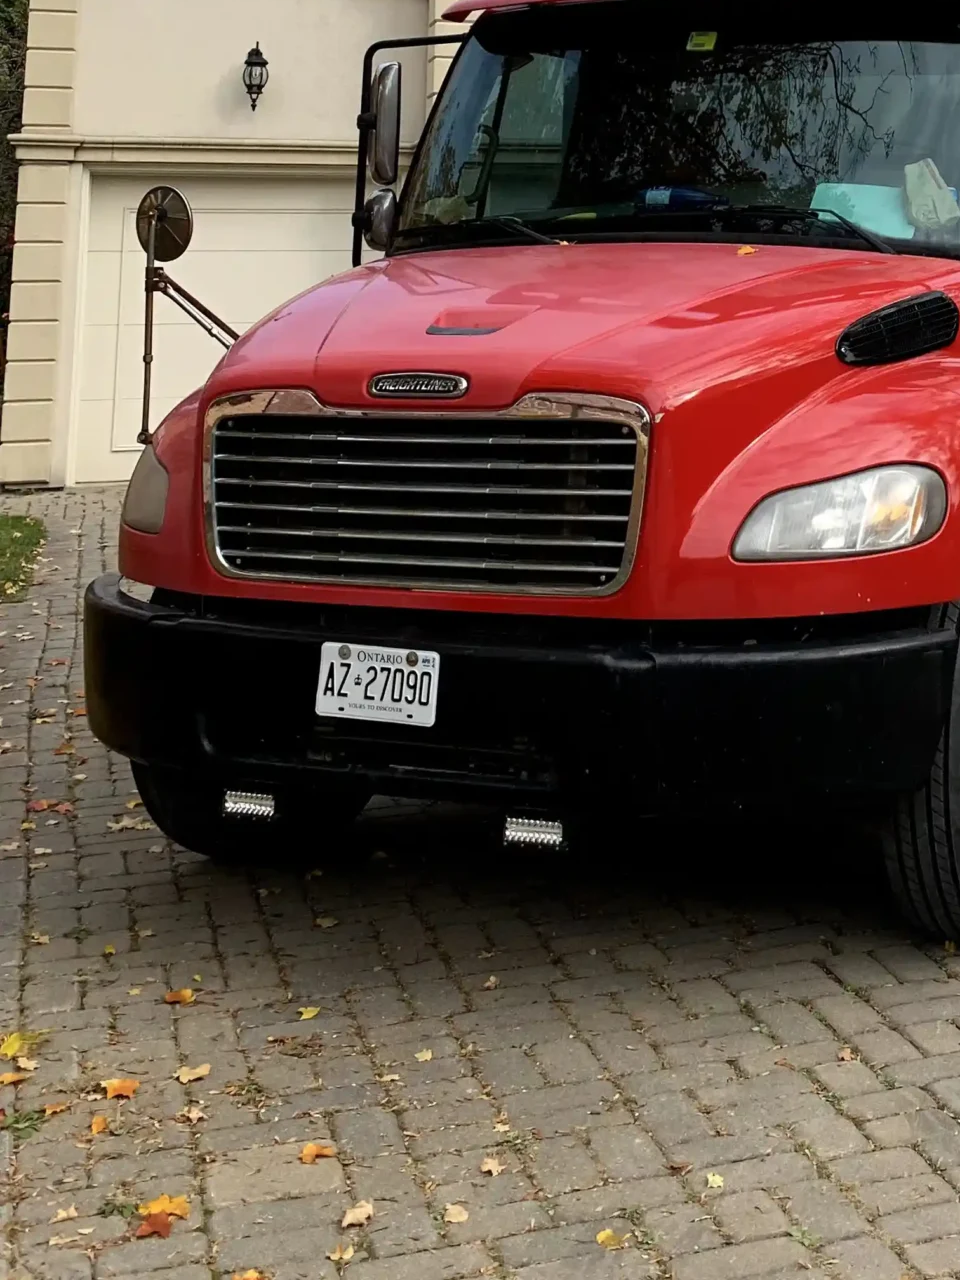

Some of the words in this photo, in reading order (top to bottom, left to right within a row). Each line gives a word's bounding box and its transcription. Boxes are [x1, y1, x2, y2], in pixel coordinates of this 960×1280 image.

[376, 378, 456, 391] FREIGHTLINER
[357, 651, 403, 665] ONTARIO
[323, 661, 352, 698] AZ
[364, 665, 432, 706] 27090
